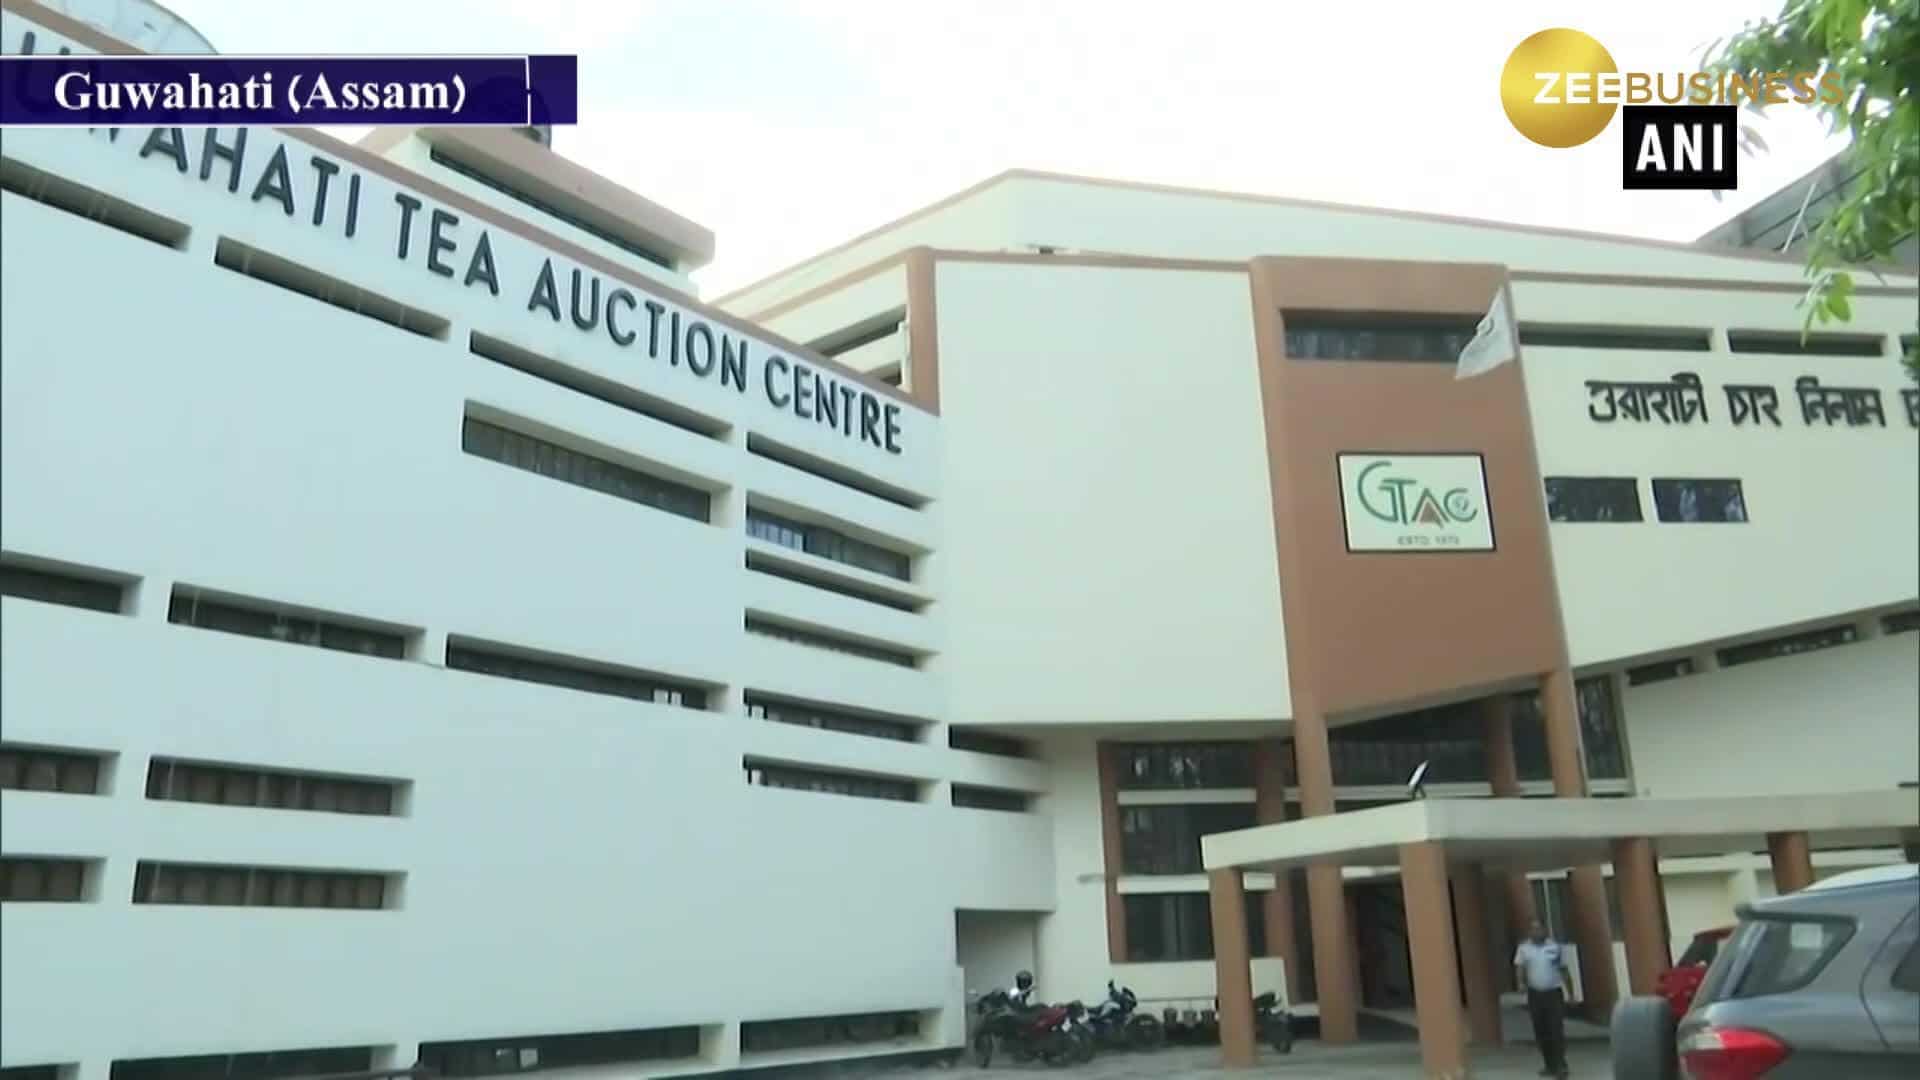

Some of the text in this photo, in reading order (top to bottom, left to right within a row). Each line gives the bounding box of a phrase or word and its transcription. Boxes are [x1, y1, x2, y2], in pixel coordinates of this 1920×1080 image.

[395, 193, 500, 297] TEA
[528, 257, 748, 393] AUCTION
[764, 355, 903, 454] CENTRE
[1357, 460, 1478, 529] GTAC
